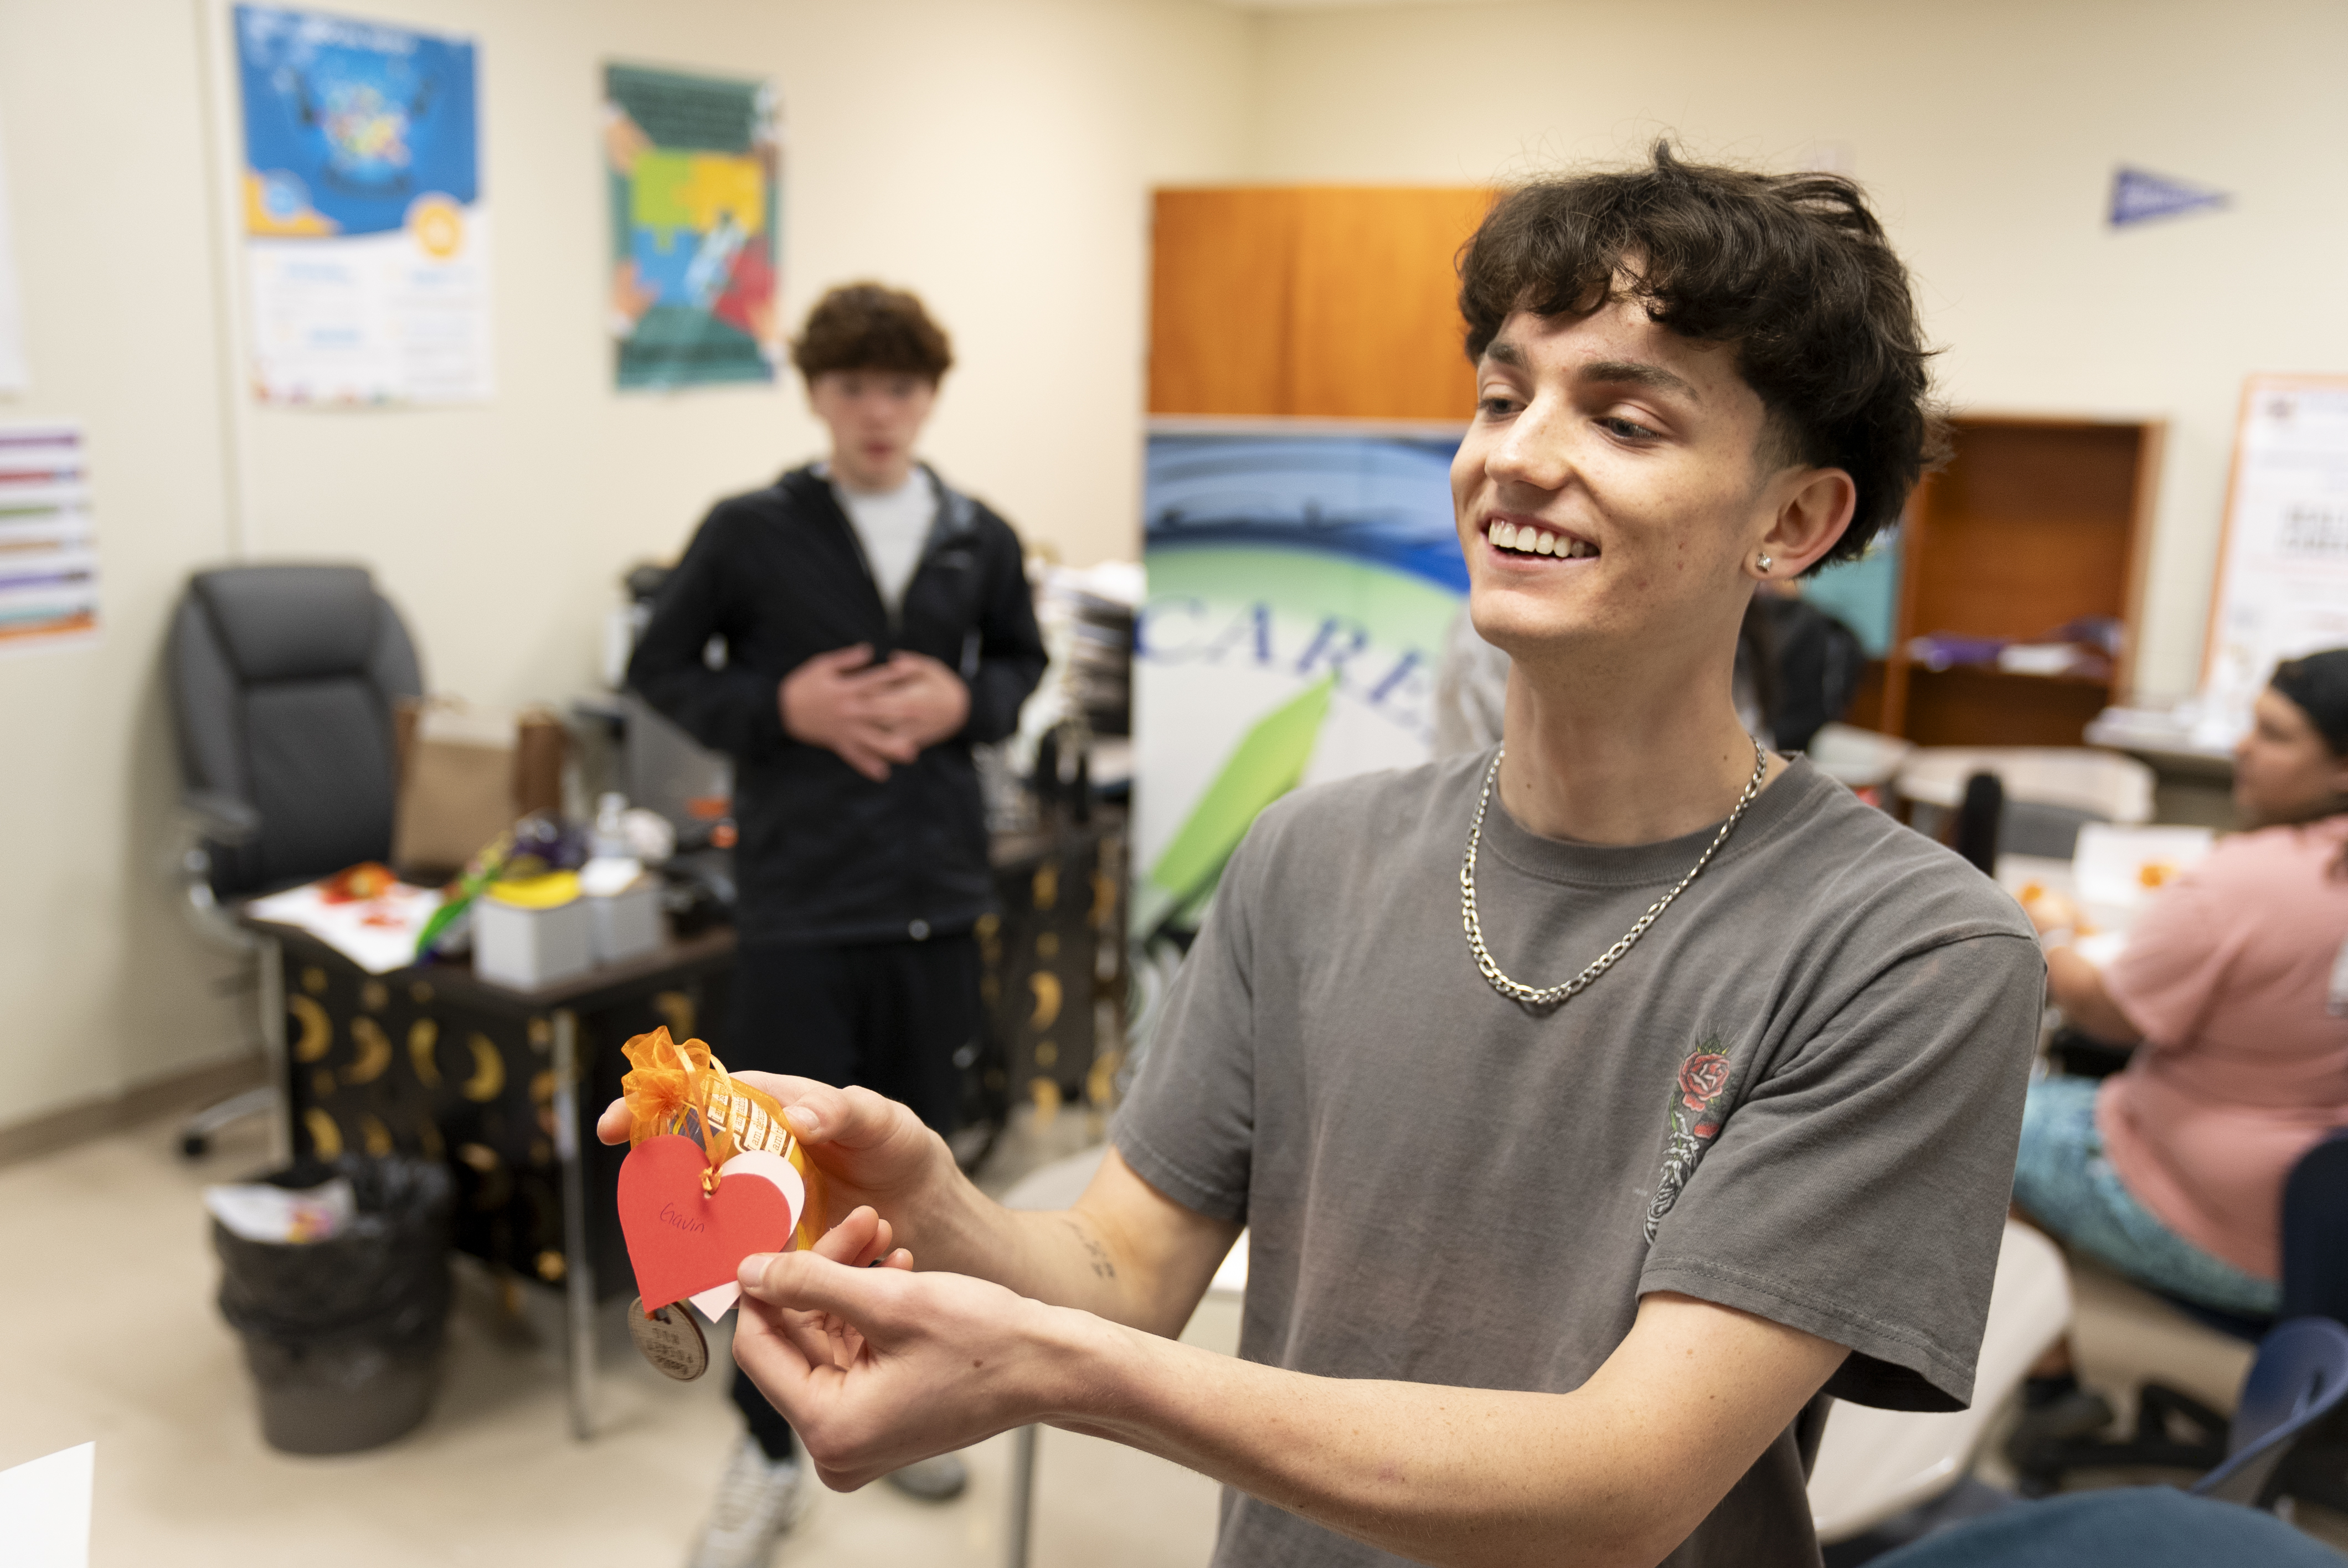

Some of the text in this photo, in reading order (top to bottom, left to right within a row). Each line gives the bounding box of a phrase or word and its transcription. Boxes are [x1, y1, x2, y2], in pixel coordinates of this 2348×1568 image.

[752, 1131, 762, 1146] am
[773, 1136, 782, 1151] am
[660, 1202, 704, 1233] Gavin
